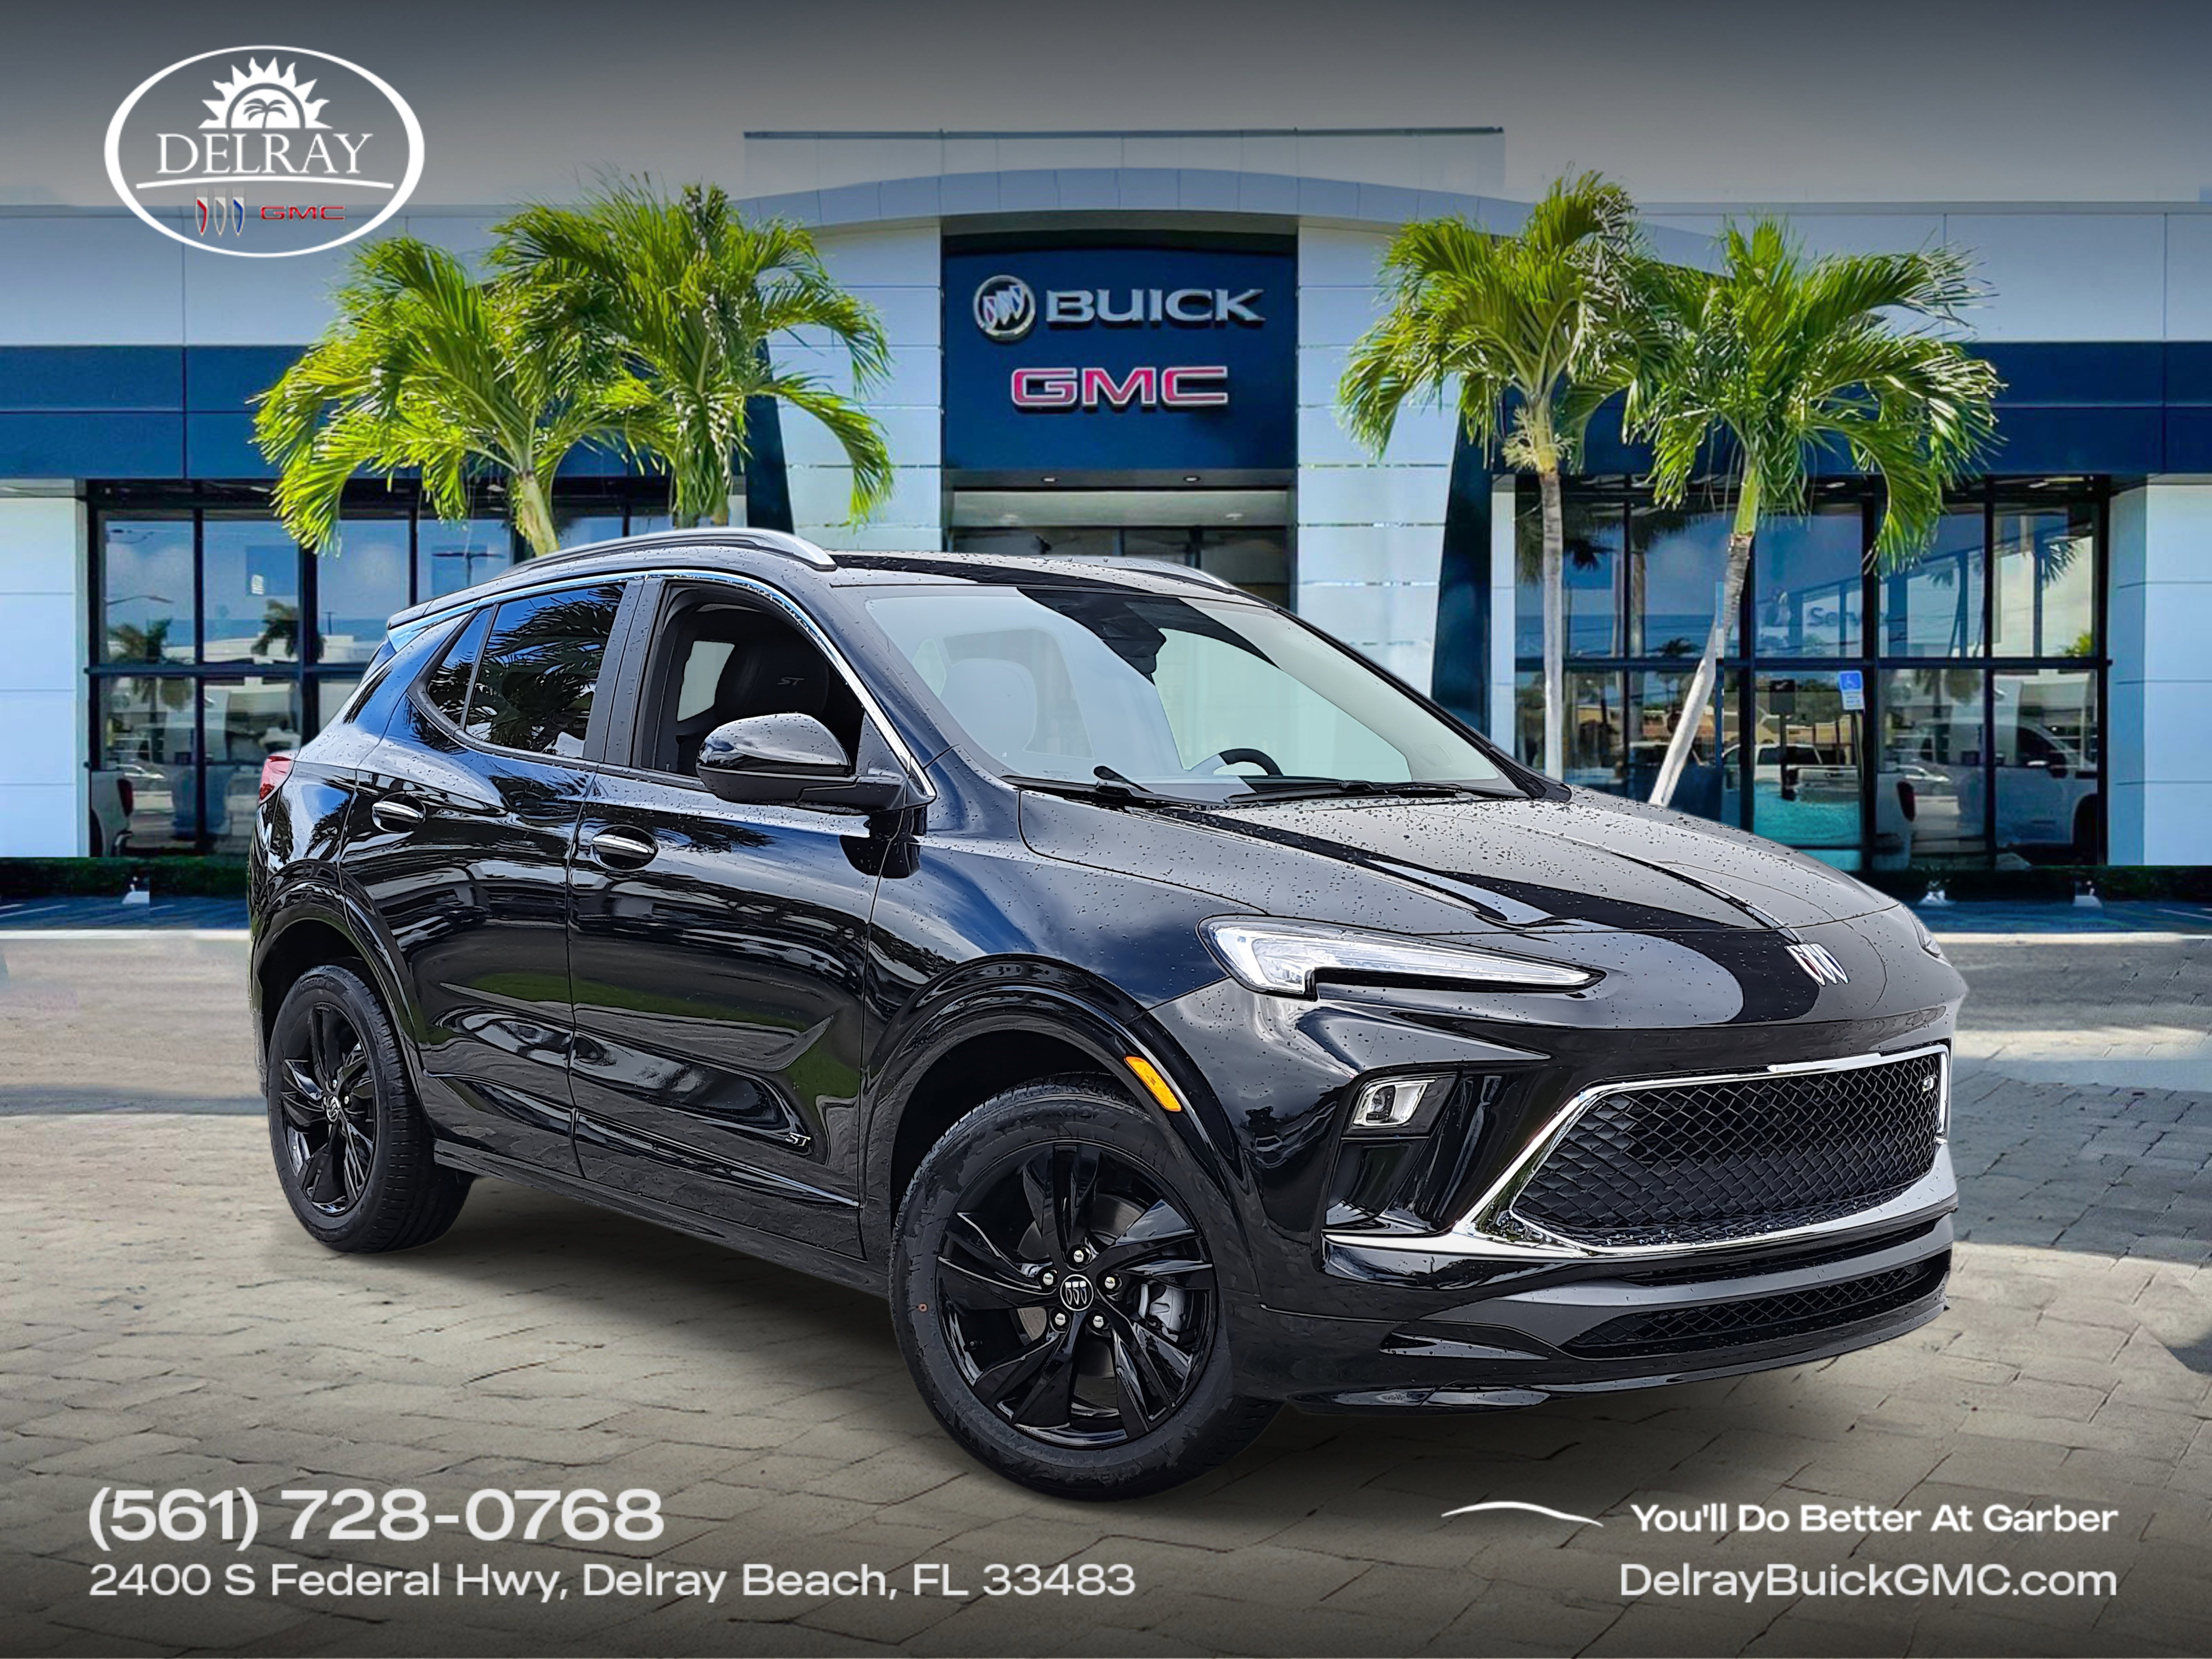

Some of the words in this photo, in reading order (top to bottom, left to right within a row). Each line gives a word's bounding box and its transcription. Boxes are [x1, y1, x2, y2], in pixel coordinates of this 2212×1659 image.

[1046, 288, 1265, 322] BUICK
[1012, 366, 1228, 406] GMC
[778, 677, 805, 686] ST
